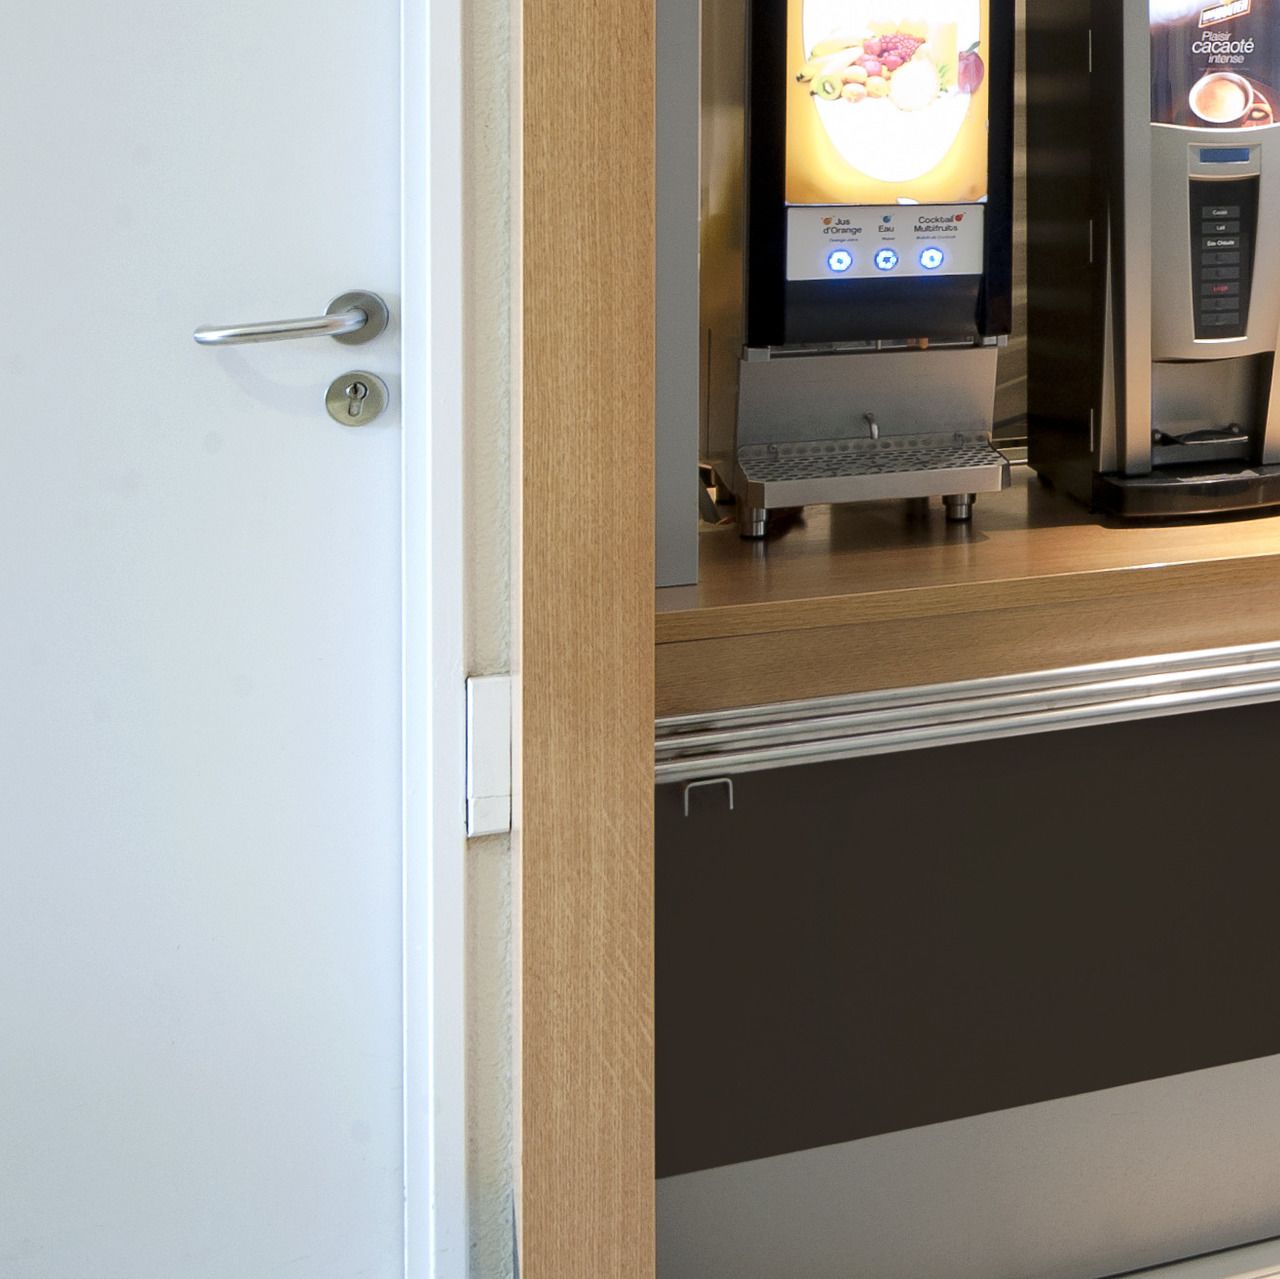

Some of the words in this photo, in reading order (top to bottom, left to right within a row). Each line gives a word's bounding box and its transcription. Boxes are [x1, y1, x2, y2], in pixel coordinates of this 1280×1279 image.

[1202, 31, 1232, 41] Plaisir
[1192, 38, 1255, 54] cacaoté
[1208, 54, 1245, 64] intense
[834, 218, 851, 226] Jus
[918, 214, 955, 224] Cocktail
[823, 226, 863, 235] d'Orange
[878, 224, 895, 233] Eau
[913, 224, 958, 233] Multifruits
